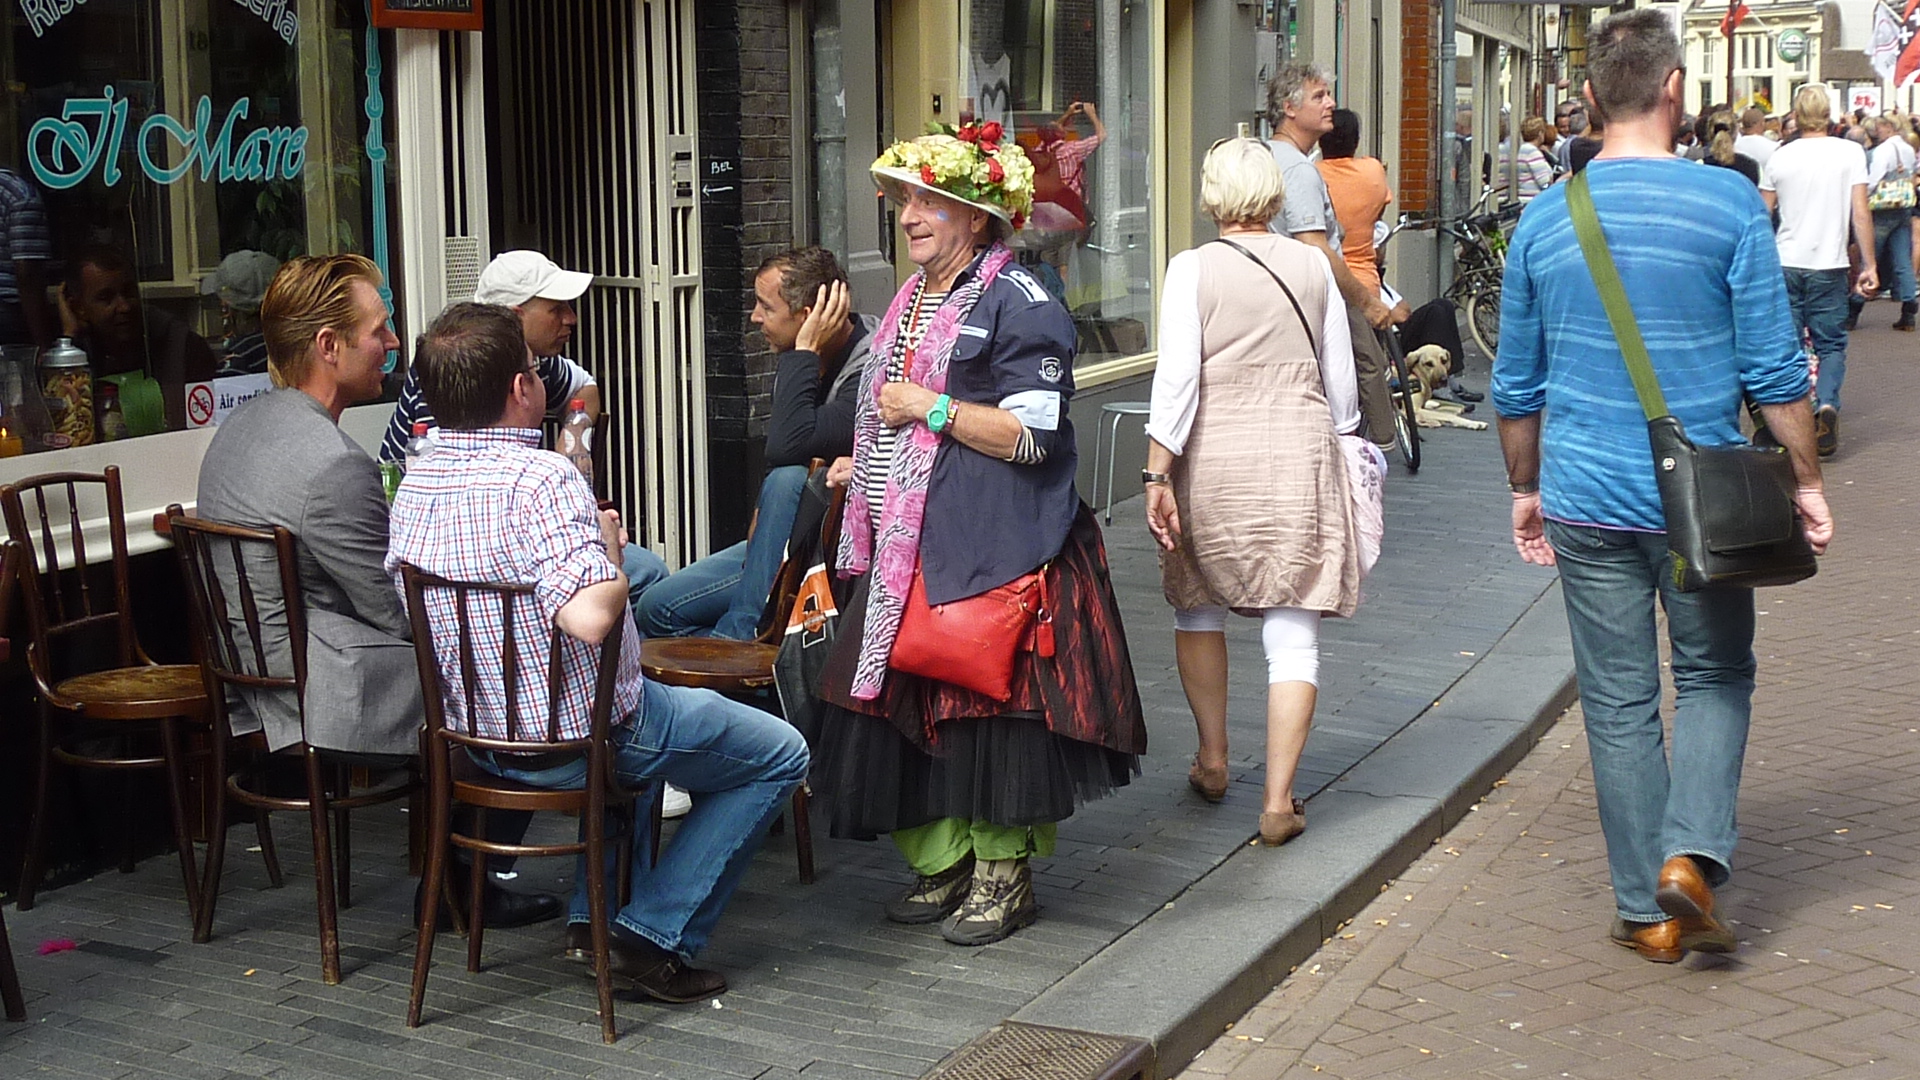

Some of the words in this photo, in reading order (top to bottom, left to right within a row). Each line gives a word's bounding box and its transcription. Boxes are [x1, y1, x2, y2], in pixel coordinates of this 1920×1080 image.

[27, 84, 129, 190] Il
[137, 94, 309, 185] Mare
[219, 393, 235, 410] Air
